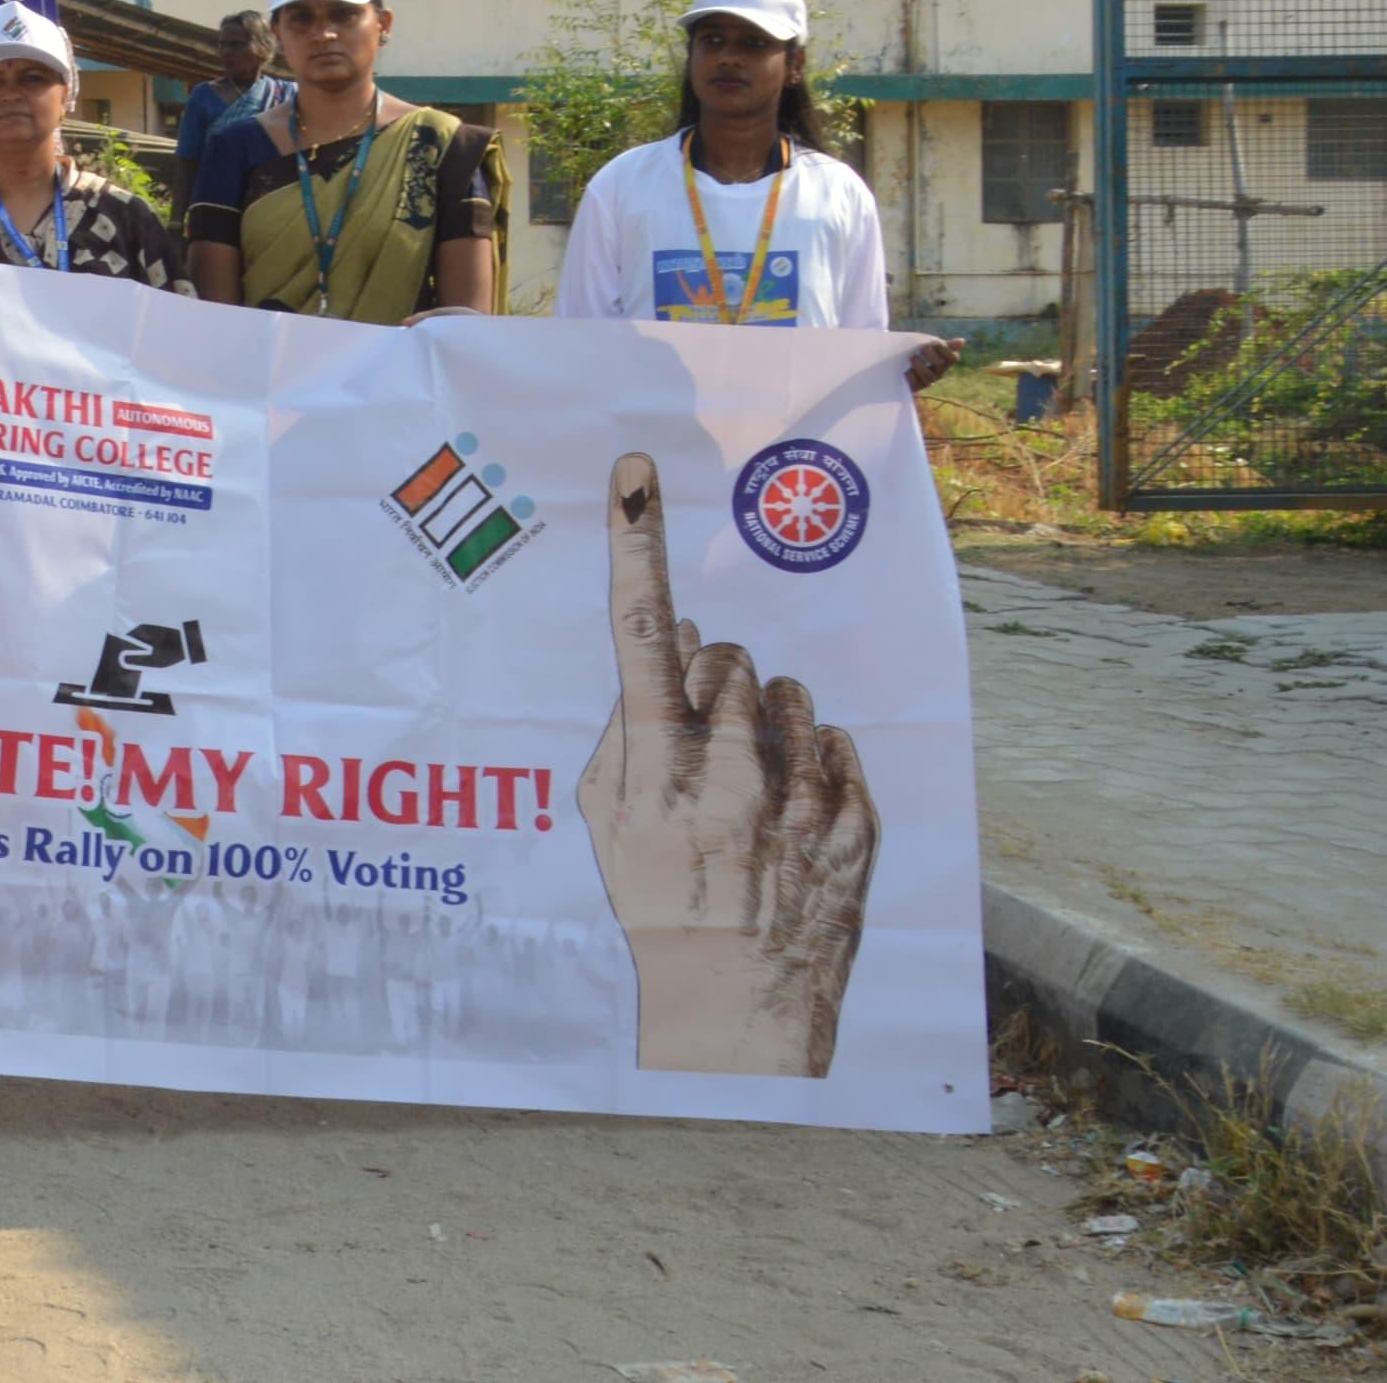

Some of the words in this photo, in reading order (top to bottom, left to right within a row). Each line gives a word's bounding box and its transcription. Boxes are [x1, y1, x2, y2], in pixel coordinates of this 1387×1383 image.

[117, 408, 211, 433] AUTONOMOUS
[75, 435, 214, 479] COLLEGE
[781, 445, 818, 462] सेवा
[8, 465, 57, 484] Approved
[57, 472, 70, 488] by
[104, 479, 159, 497] Accredited
[160, 485, 172, 502] by
[173, 488, 204, 503] NAAC
[59, 497, 135, 519] COIMBATORE
[144, 509, 164, 523] 641
[743, 511, 781, 557] NATIONAL
[781, 547, 832, 563] SERVICE
[828, 512, 861, 554] SCHEME
[114, 742, 255, 813] MY
[279, 753, 553, 833] RIGHT!
[23, 826, 126, 883] Rally
[139, 847, 193, 876] on
[207, 841, 314, 884] 100%
[327, 849, 469, 907] Voting
